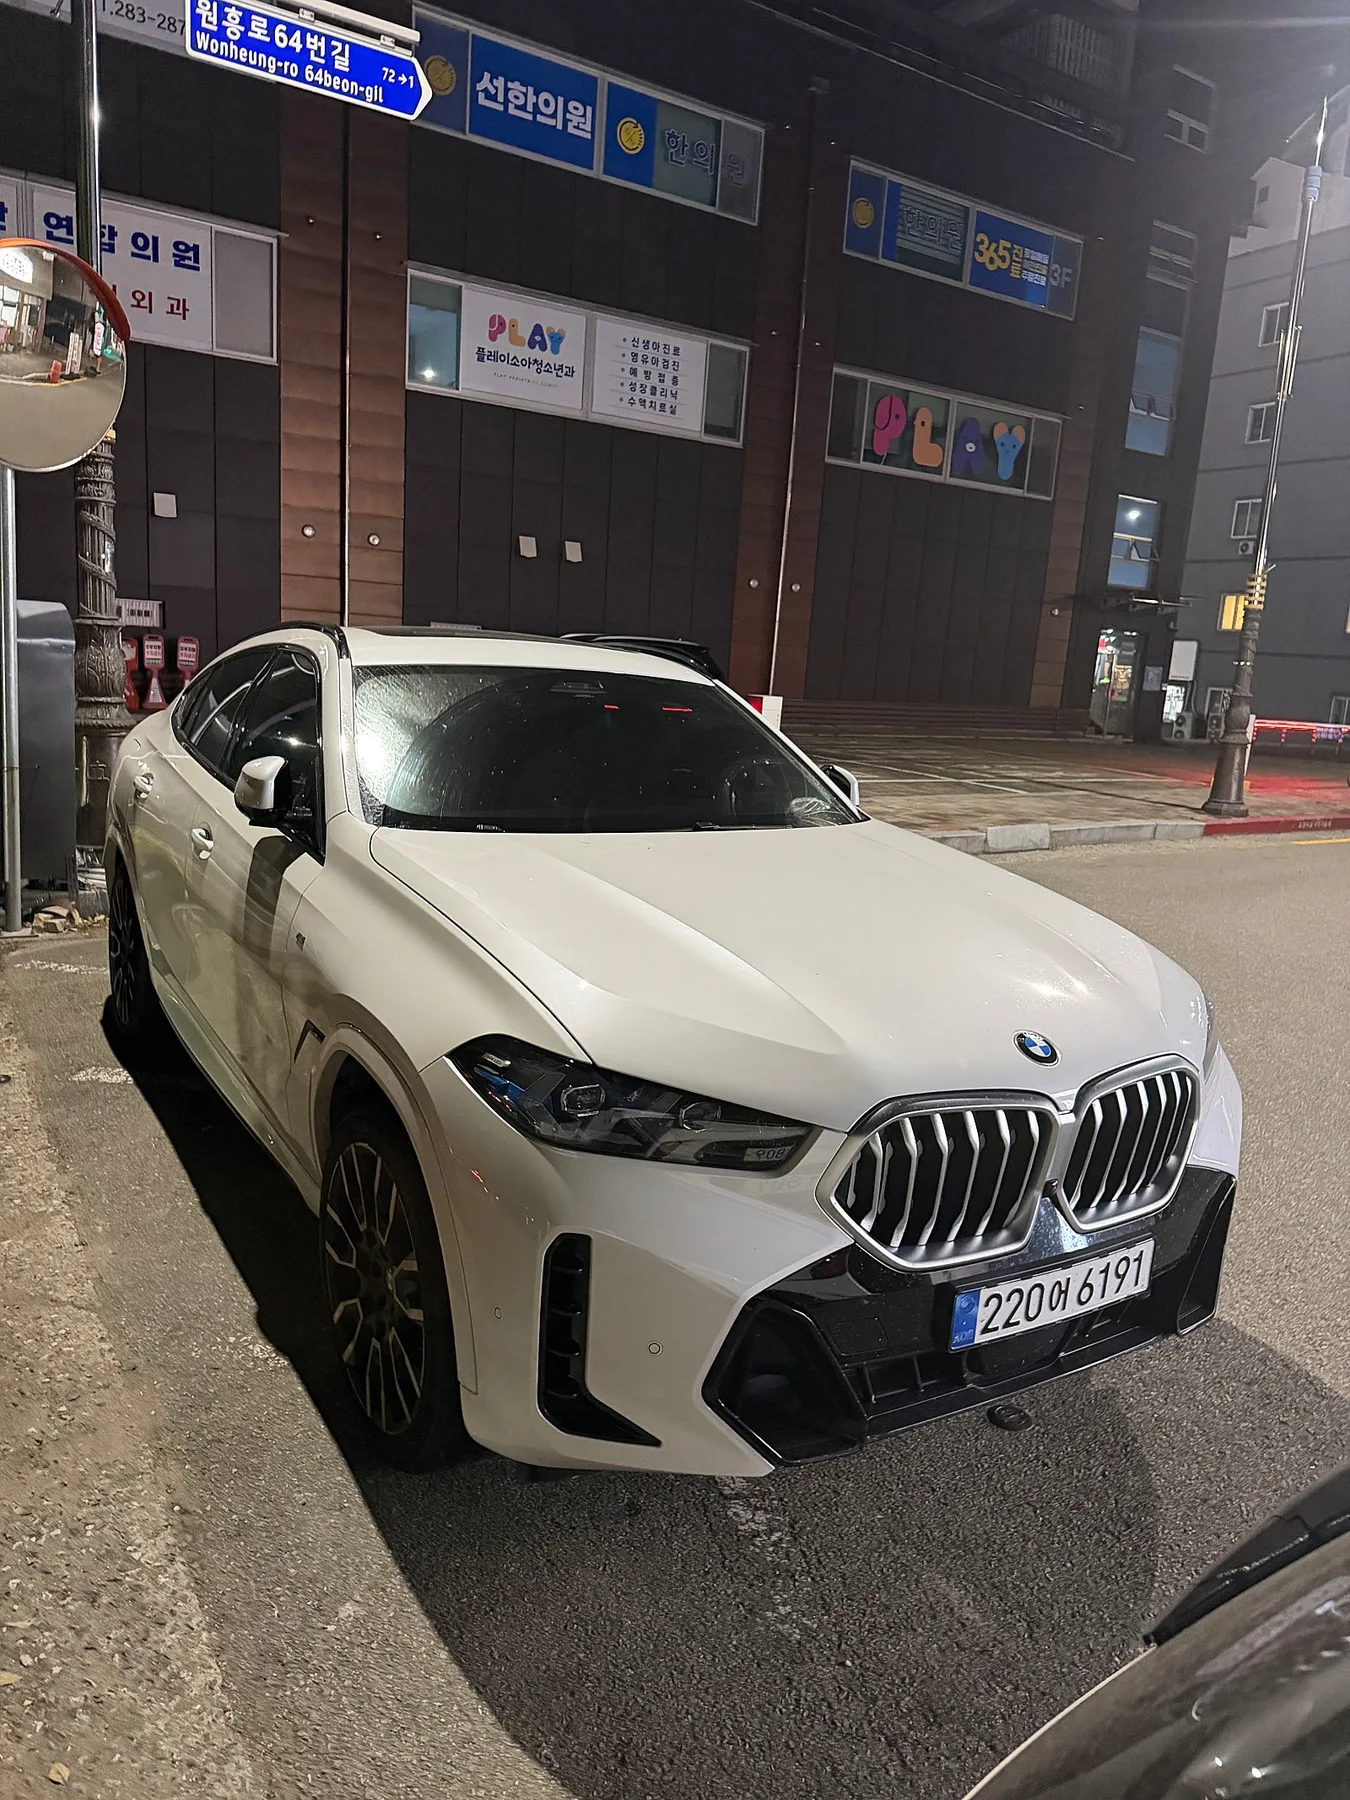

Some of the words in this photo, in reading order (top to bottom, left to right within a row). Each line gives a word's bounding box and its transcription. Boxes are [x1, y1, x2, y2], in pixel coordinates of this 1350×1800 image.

[195, 0, 350, 72] 원흥로64번길
[195, 30, 299, 77] Wonheung-ro
[304, 65, 384, 103] 64beon-gil
[381, 67, 396, 83] 72
[476, 71, 593, 140] 선한의원
[974, 232, 1012, 271] 365
[1049, 262, 1073, 288] 3F
[488, 313, 567, 355] PLAY
[631, 337, 681, 357] 신생아진료
[475, 346, 576, 378] 플레이소아청소년과
[630, 351, 680, 372] 영유아검진
[628, 396, 677, 416] 수액치료실
[629, 381, 678, 401] 성장클리닉
[872, 395, 1026, 481] PLAY
[1077, 1250, 1144, 1307] 6191
